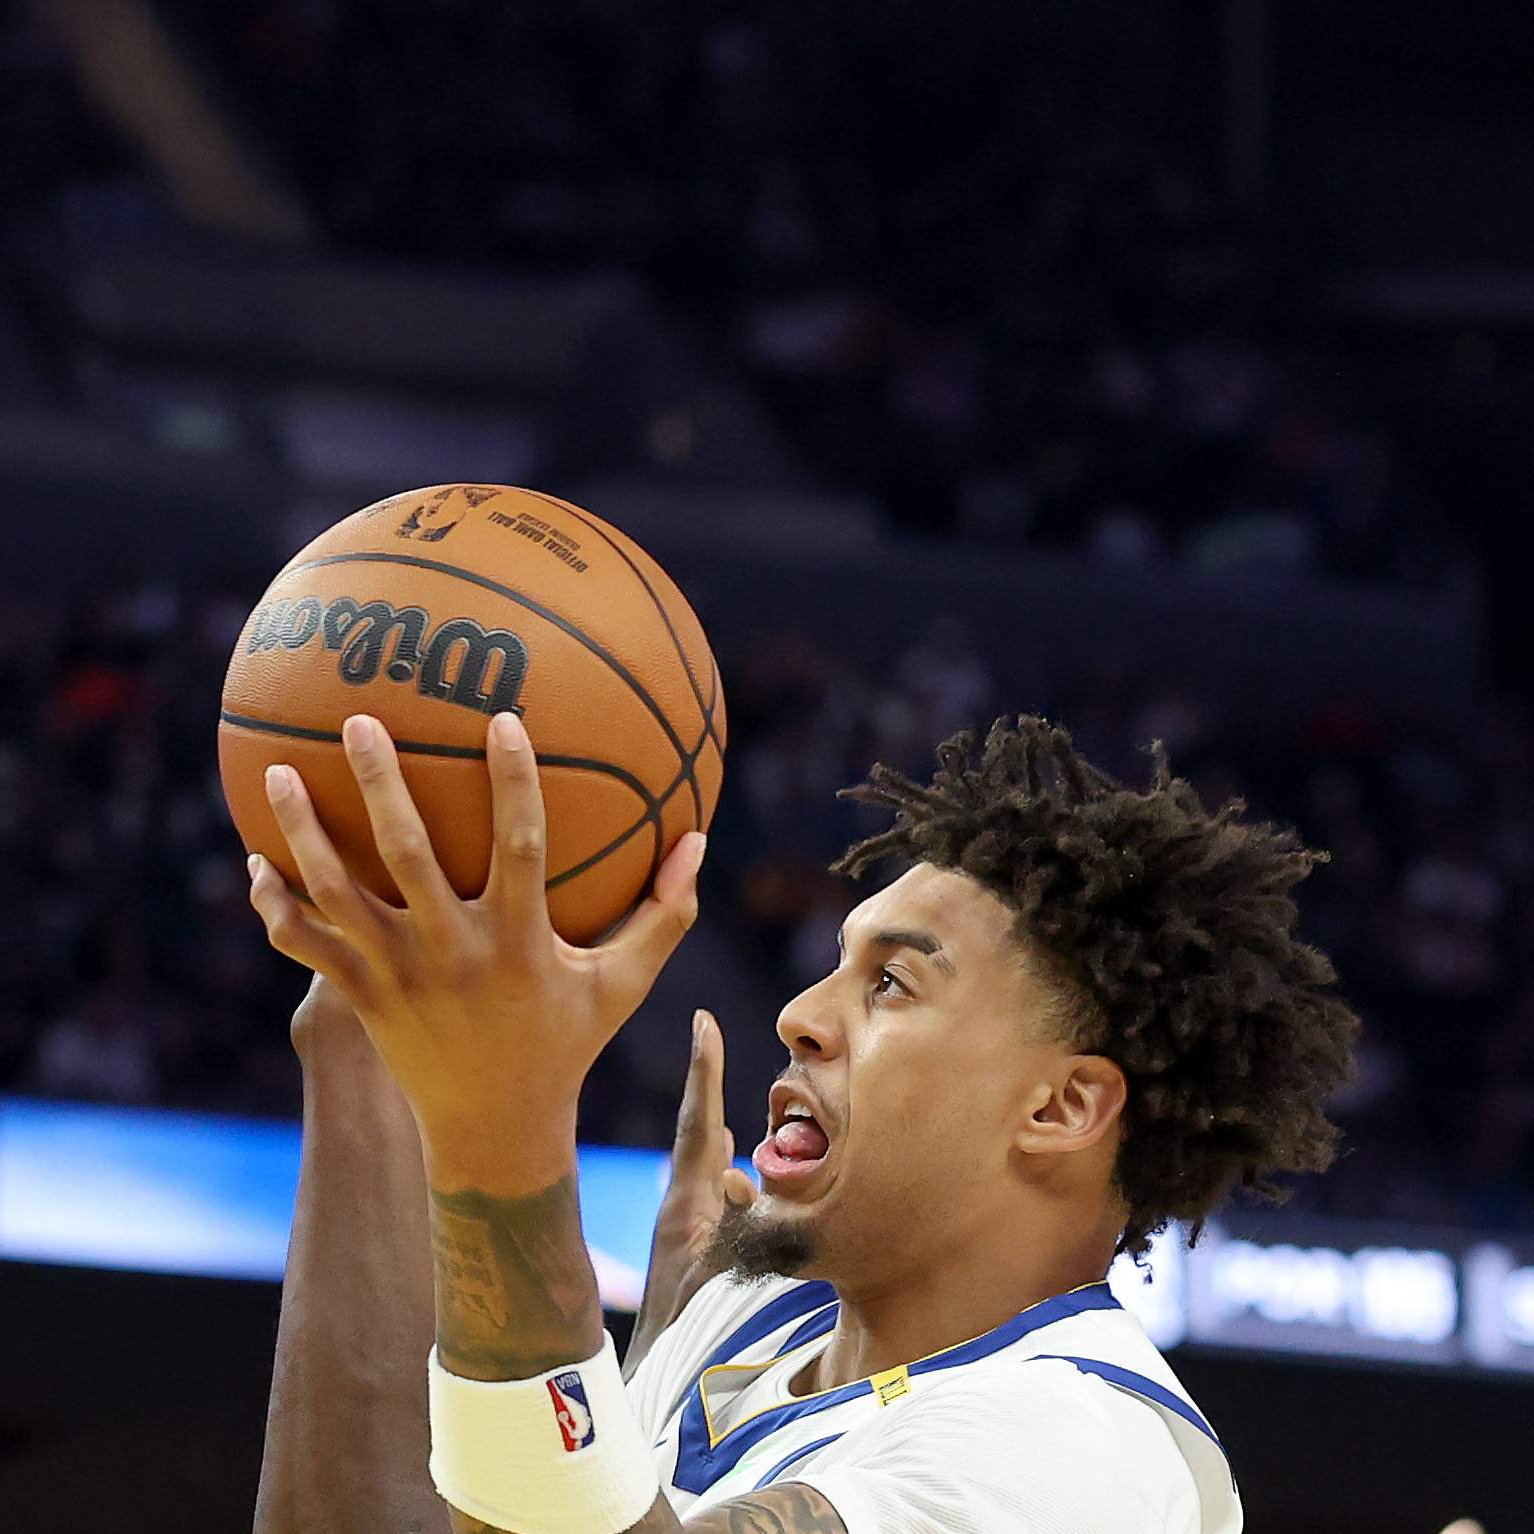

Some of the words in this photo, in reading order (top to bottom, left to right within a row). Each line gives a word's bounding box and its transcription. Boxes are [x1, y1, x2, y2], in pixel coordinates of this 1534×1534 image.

[488, 511, 517, 528] BALL
[512, 521, 546, 543] GAME
[543, 538, 589, 573] OFFICIAL
[245, 596, 531, 716] Wilson
